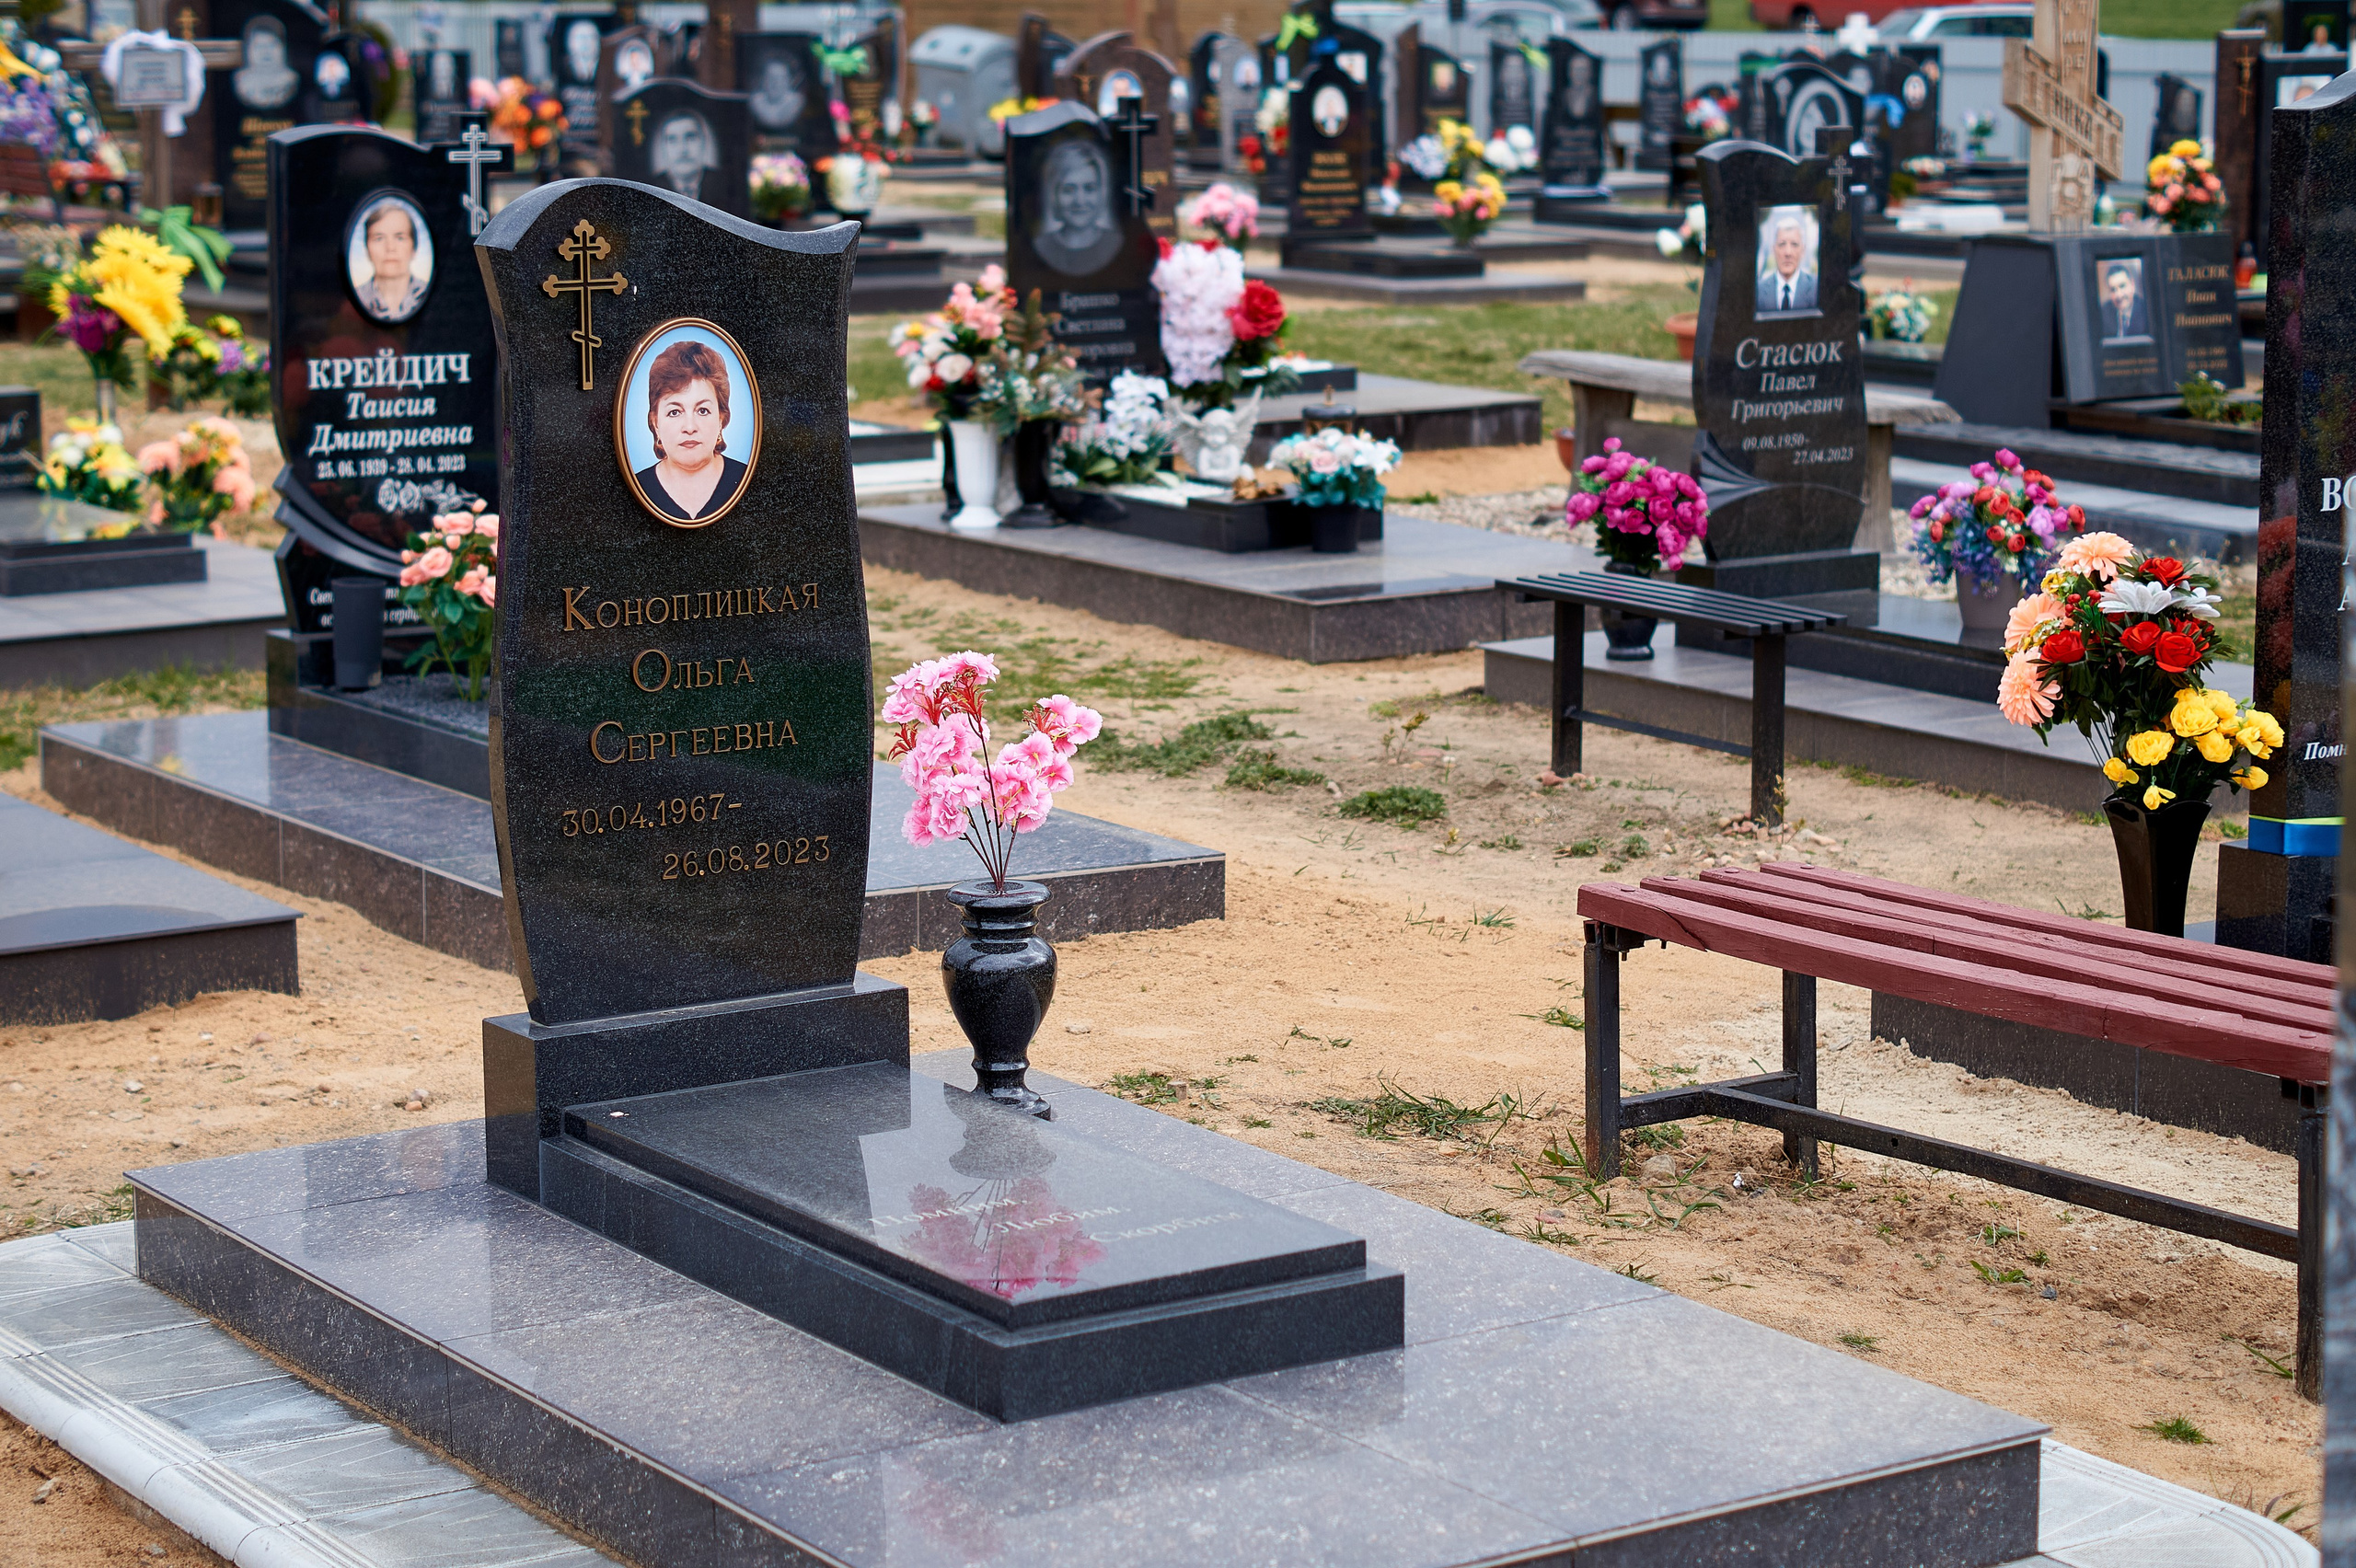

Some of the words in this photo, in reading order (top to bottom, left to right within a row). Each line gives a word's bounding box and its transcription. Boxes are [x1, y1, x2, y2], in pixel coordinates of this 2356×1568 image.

[2167, 264, 2230, 282] ГАЛАСЮК
[1735, 338, 1843, 369] Стасюк
[307, 349, 472, 391] КРЕЙДИЧ
[1760, 372, 1817, 393] Павел
[345, 391, 438, 421] Таисия
[1730, 398, 1844, 423] Григорьевич
[308, 423, 475, 457] Дмитриевна
[437, 455, 467, 474] 2023
[1793, 446, 1854, 466] 27.04.2023
[561, 792, 743, 838] 30.04.1967-
[662, 835, 831, 881] 26.08.2023
